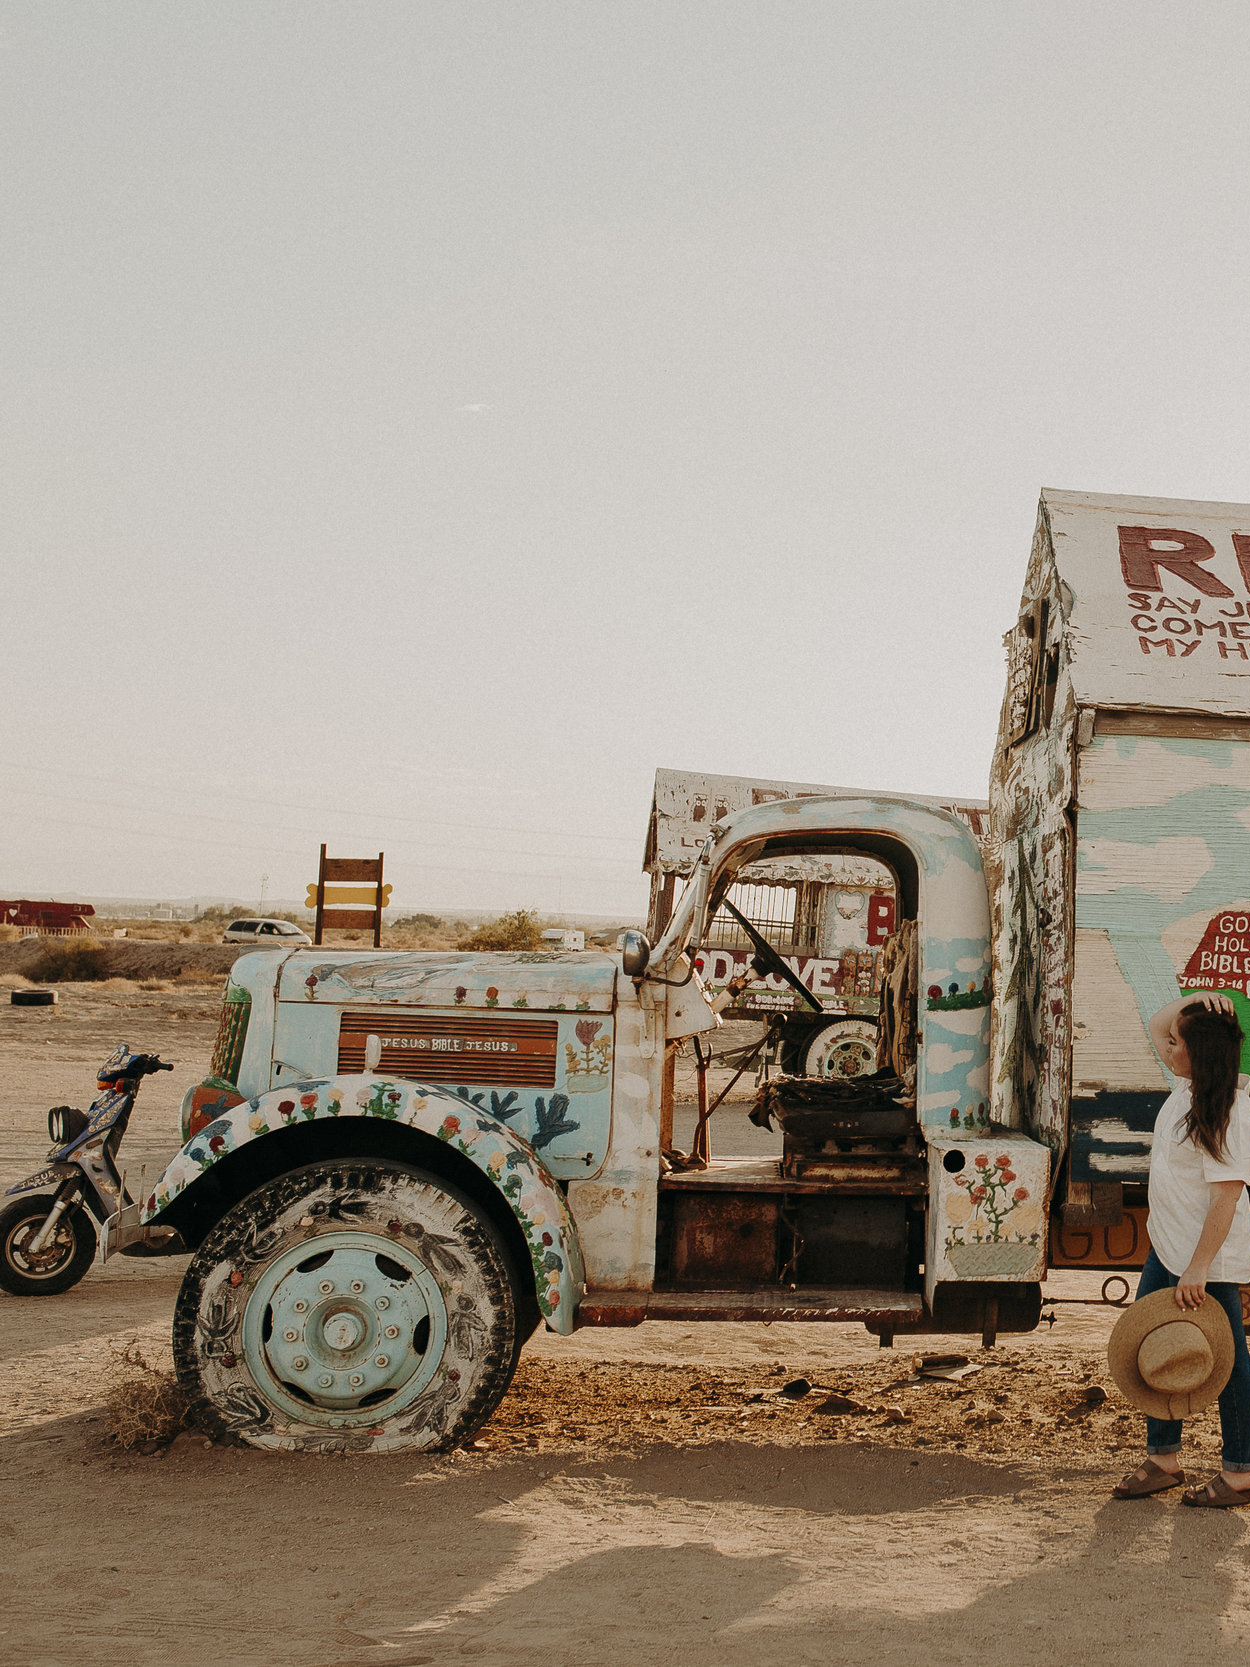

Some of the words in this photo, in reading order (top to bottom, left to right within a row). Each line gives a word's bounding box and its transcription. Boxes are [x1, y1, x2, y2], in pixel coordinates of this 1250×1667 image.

[1128, 592, 1201, 613] SAY
[1138, 636, 1201, 657] MY
[1178, 975, 1214, 988] JOHN
[381, 1037, 426, 1049] JESUS
[431, 1038, 462, 1051] BIBLE
